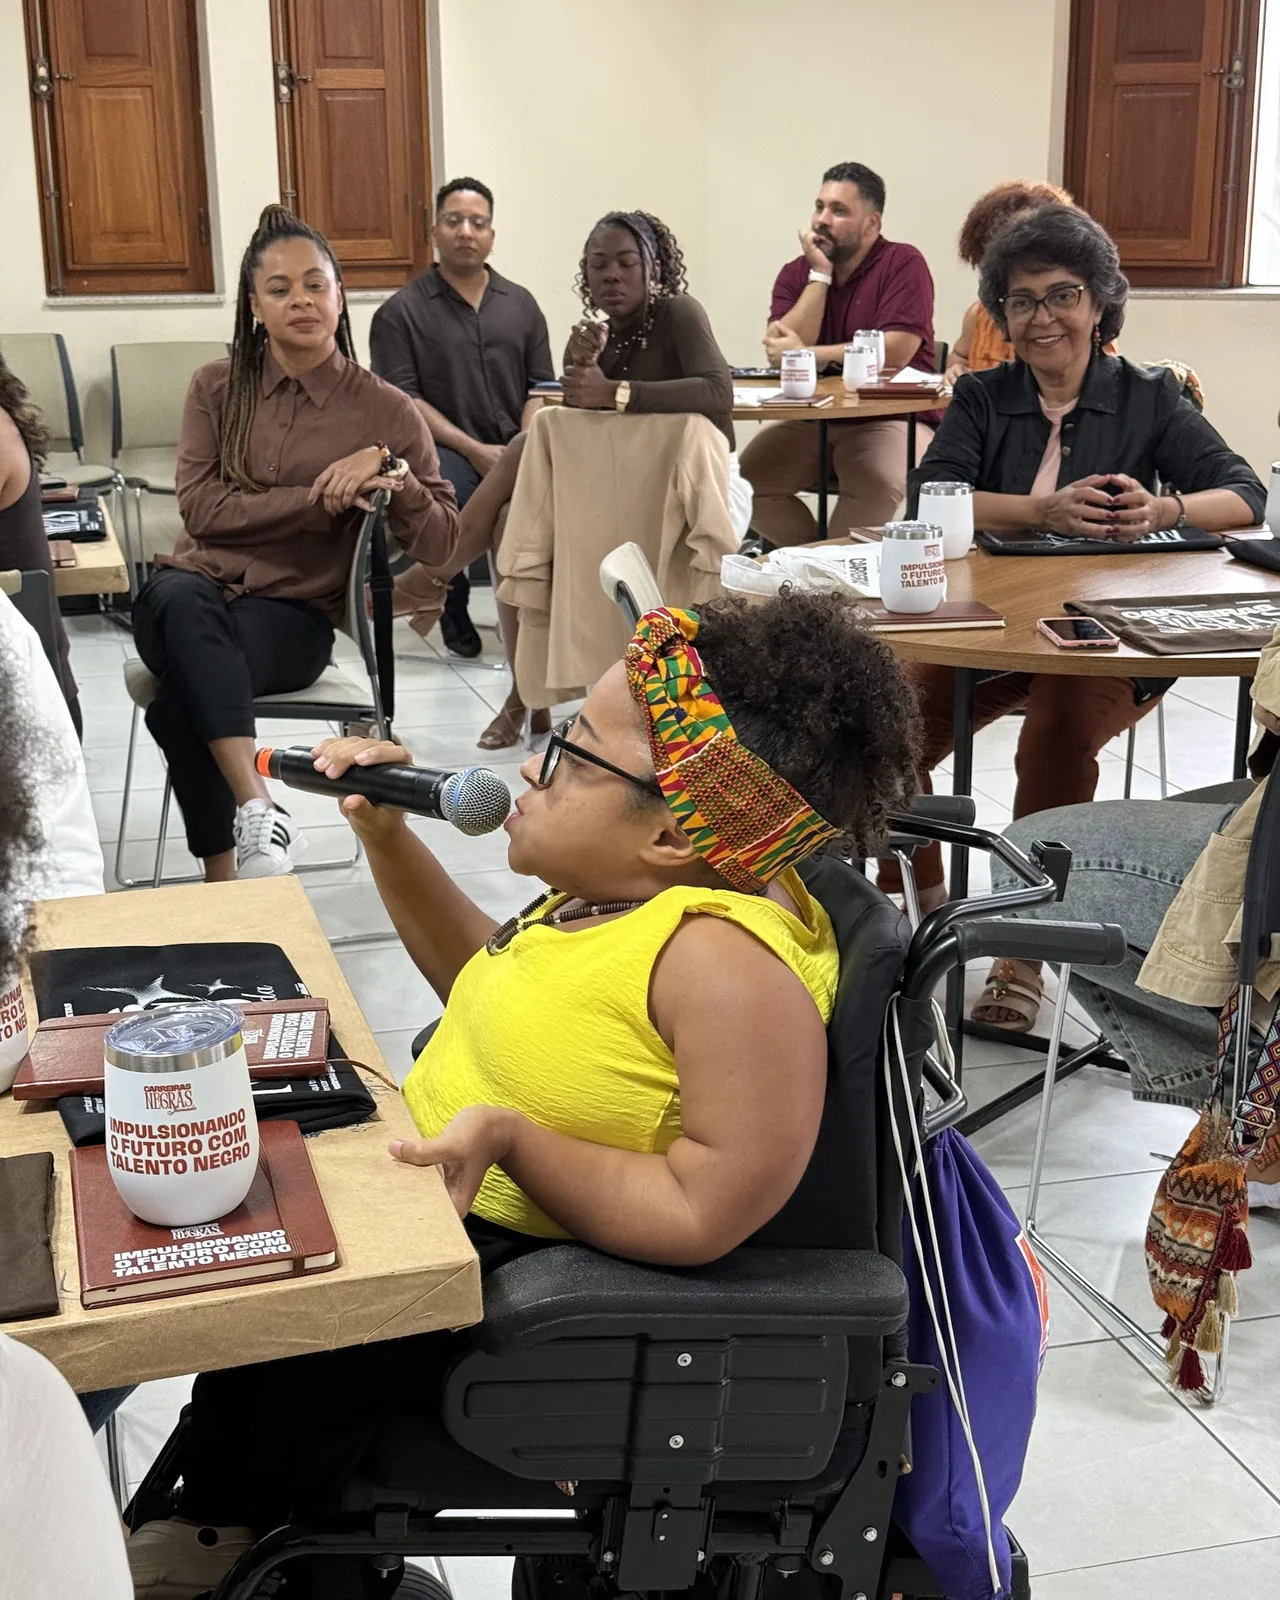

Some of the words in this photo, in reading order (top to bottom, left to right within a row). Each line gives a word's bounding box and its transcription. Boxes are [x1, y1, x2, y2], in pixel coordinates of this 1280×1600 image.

[900, 577, 938, 588] TALENTO
[901, 572, 908, 580] O
[280, 1027, 298, 1052] FUTURO
[294, 1030, 313, 1058] TALENTO
[144, 1083, 191, 1092] CARREIRAS
[145, 1091, 194, 1111] NEGRAS
[110, 1108, 245, 1139] IMPULSIONANDO
[111, 1135, 118, 1150] O
[121, 1139, 202, 1157] FUTURO
[208, 1125, 246, 1151] COM
[110, 1151, 187, 1175] TALENTO
[194, 1142, 250, 1172] NEGRO
[114, 1230, 286, 1261] IMPULSIONANDO
[115, 1259, 132, 1269] O
[137, 1244, 228, 1266] FUTURO
[233, 1237, 286, 1250] COM
[112, 1255, 214, 1277] TALENTO
[219, 1244, 292, 1262] NEGRO
